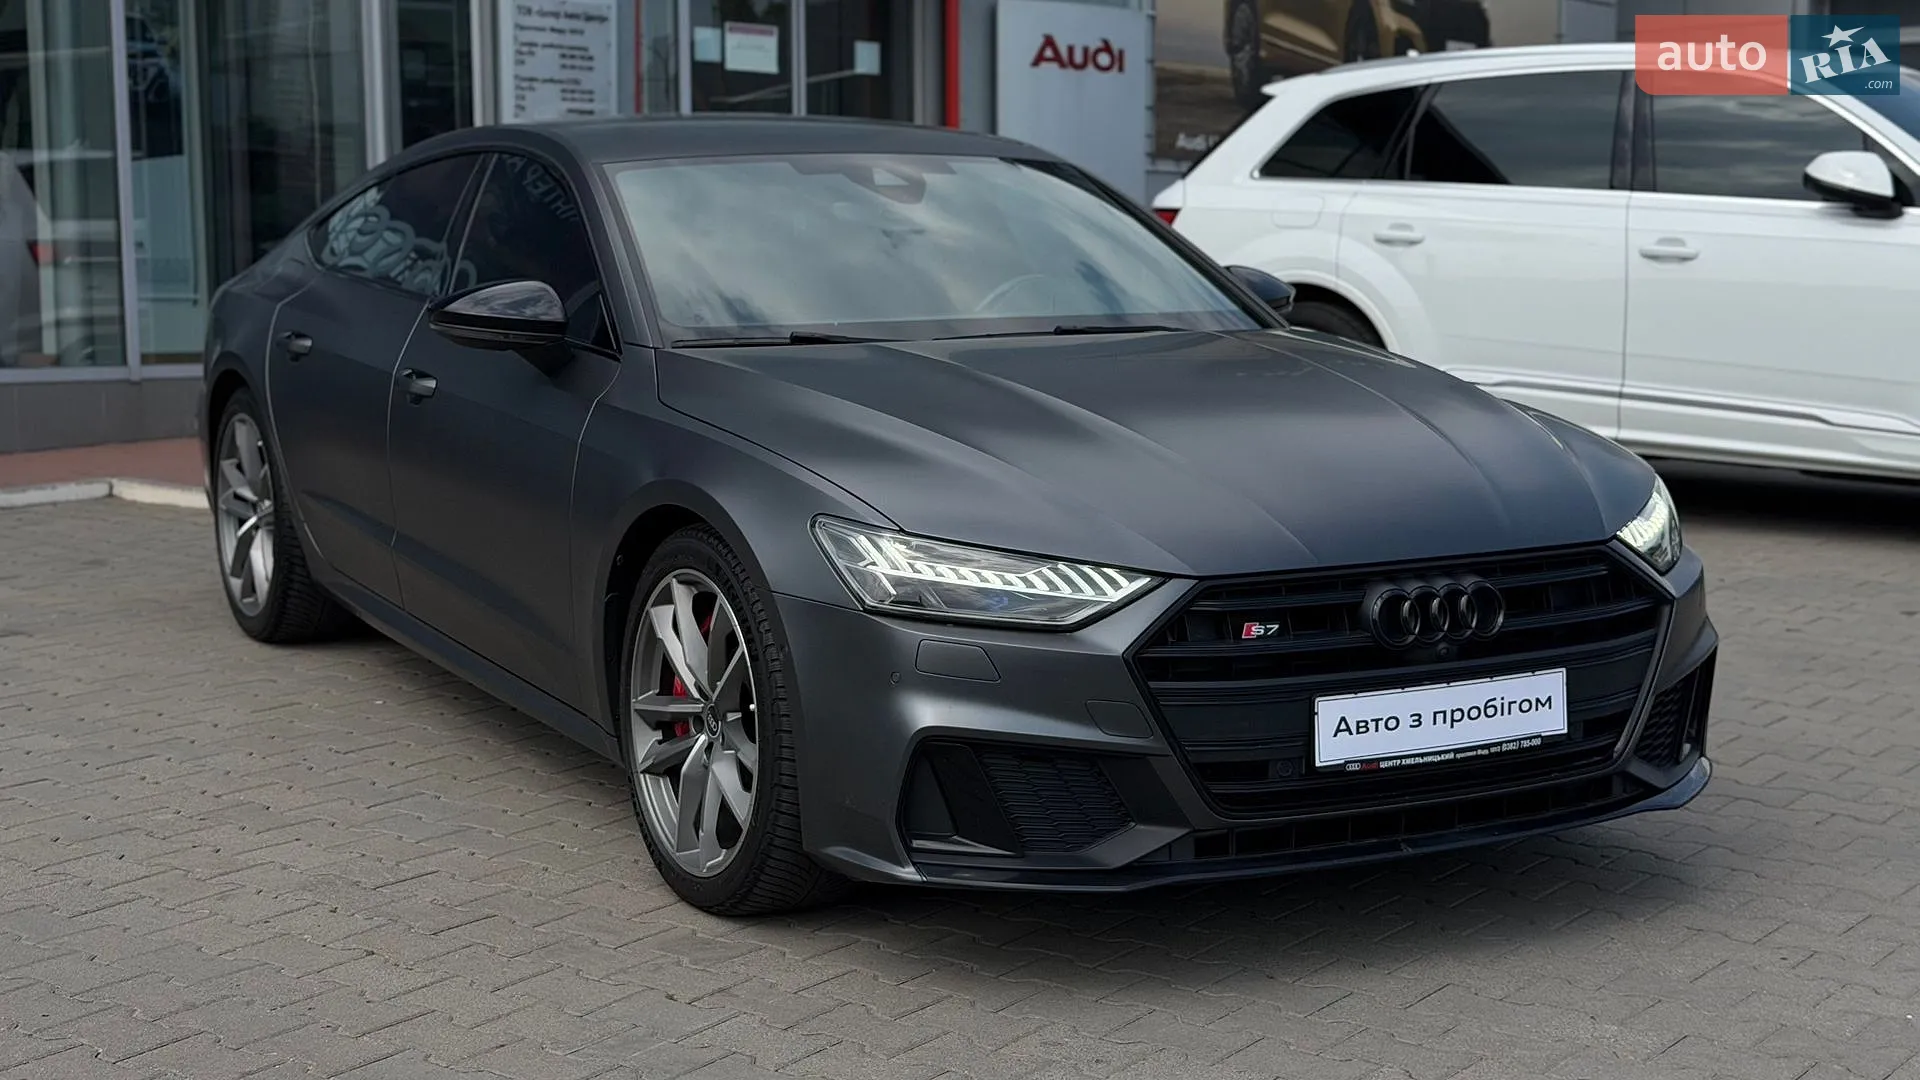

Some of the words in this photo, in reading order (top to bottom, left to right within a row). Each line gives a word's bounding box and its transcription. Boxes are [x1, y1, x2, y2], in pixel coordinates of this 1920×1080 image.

[1029, 33, 1125, 74] Audi
[1250, 623, 1280, 637] S7
[1332, 715, 1401, 738] Авто
[1408, 712, 1423, 729] з
[1432, 695, 1553, 729] пробігом
